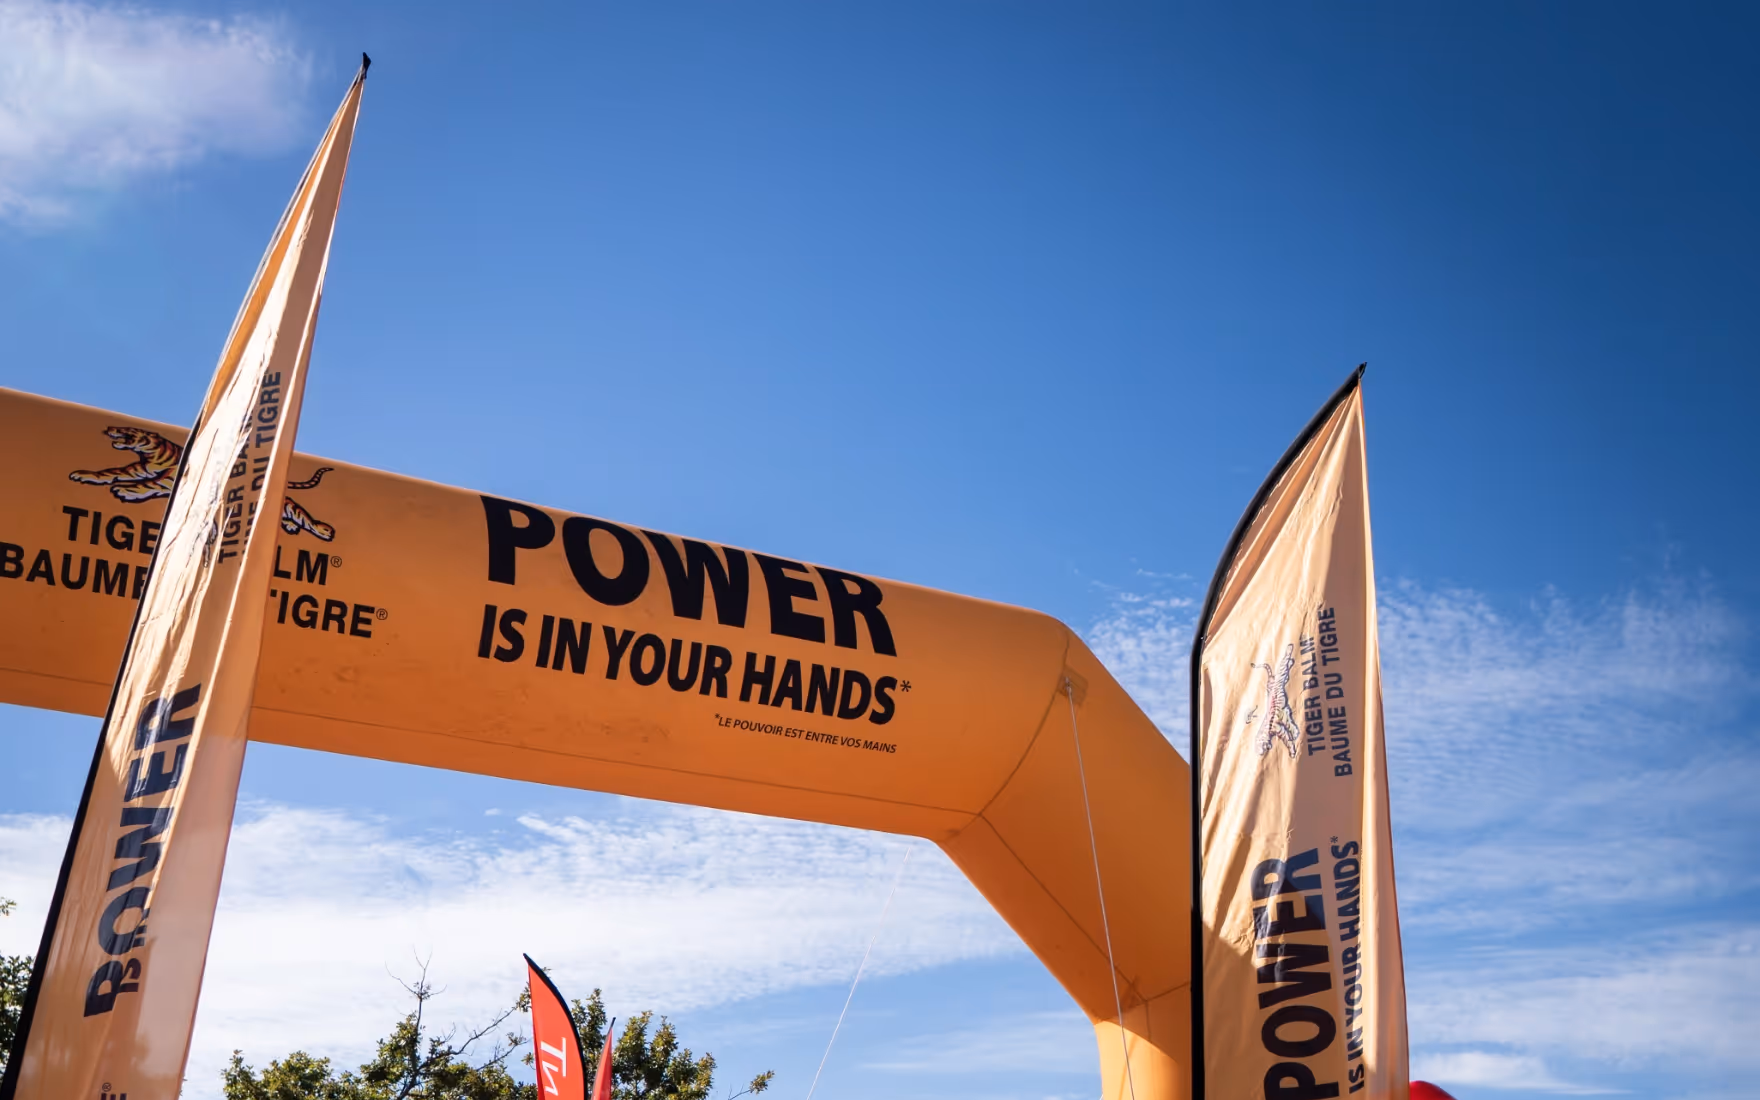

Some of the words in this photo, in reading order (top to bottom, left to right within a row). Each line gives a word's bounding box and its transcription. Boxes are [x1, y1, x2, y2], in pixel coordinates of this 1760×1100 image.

[62, 505, 160, 554] TIGE
[480, 494, 897, 657] POWER
[478, 604, 528, 663] IS
[535, 615, 593, 675] IN
[602, 625, 733, 699] YOUR
[1325, 672, 1345, 701] DU
[733, 719, 783, 736] POUVOIR
[784, 727, 805, 740] EST
[805, 730, 839, 745] ENTRE
[840, 736, 861, 749] VOS
[862, 740, 897, 754] MAINS
[1304, 694, 1326, 756] TIGER
[1328, 706, 1353, 777] BAUME
[84, 683, 201, 1018] POWER
